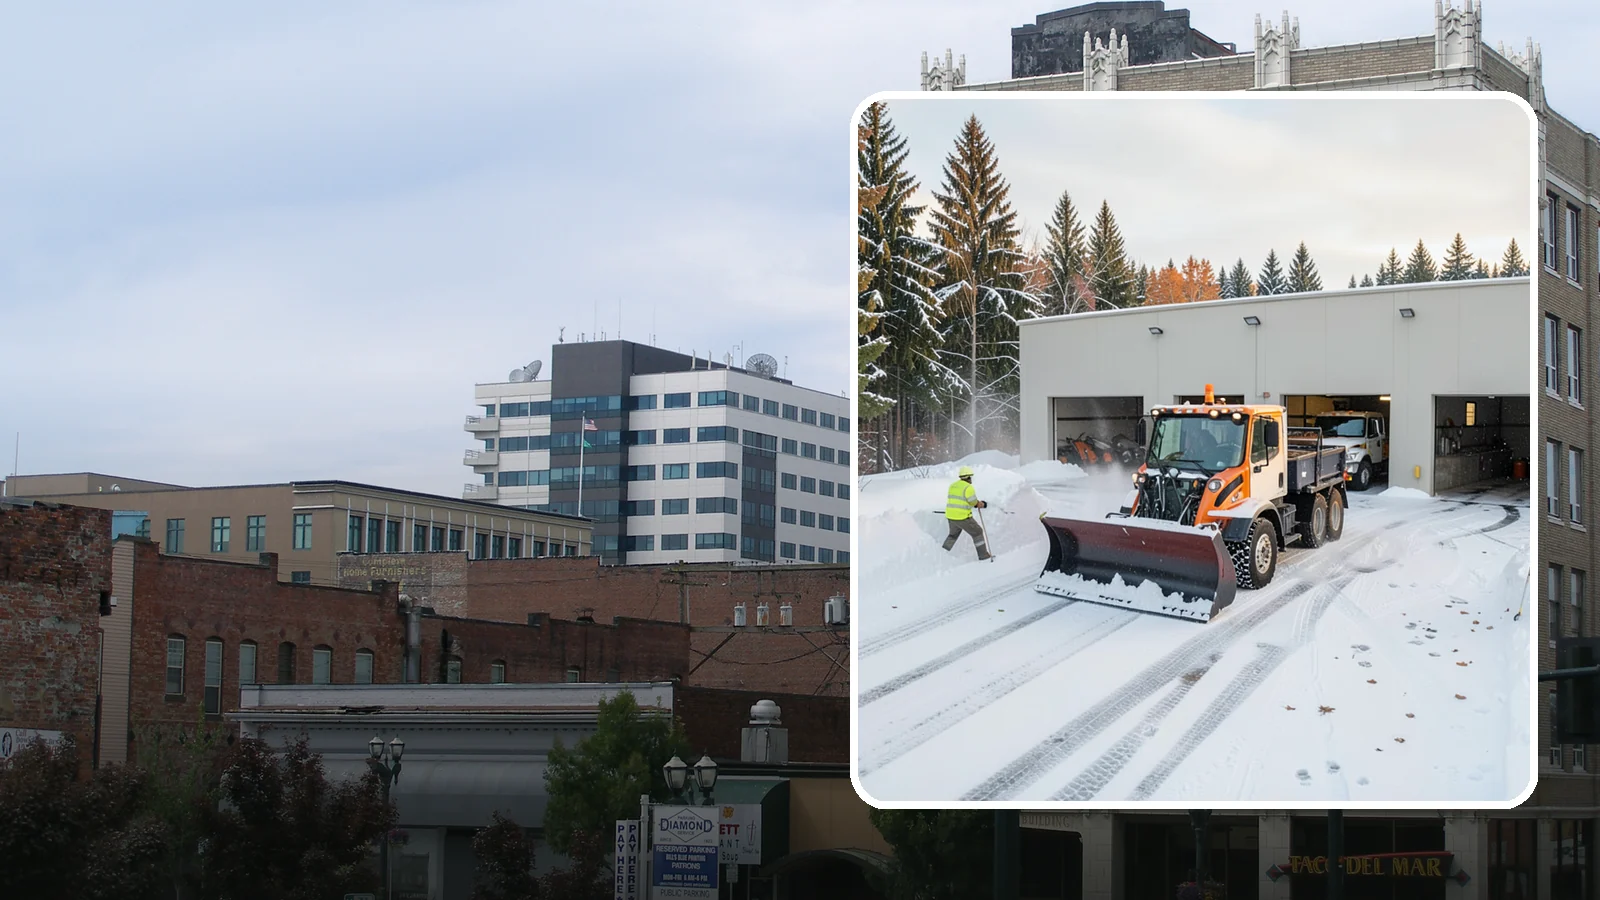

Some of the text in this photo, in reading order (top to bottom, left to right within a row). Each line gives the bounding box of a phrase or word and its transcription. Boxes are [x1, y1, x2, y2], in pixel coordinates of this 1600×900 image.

[343, 566, 427, 577] Home Furnishers
[660, 818, 713, 833] DIAMOND
[1022, 815, 1070, 828] BUILDING
[656, 845, 716, 854] RESERVED PARKING
[616, 824, 625, 894] PAY HERE
[627, 824, 637, 893] PAY HERE
[671, 862, 701, 870] PATRONS
[1290, 855, 1442, 877] TAC DEL MAR
[660, 888, 710, 898] PUBLIC PARKING
